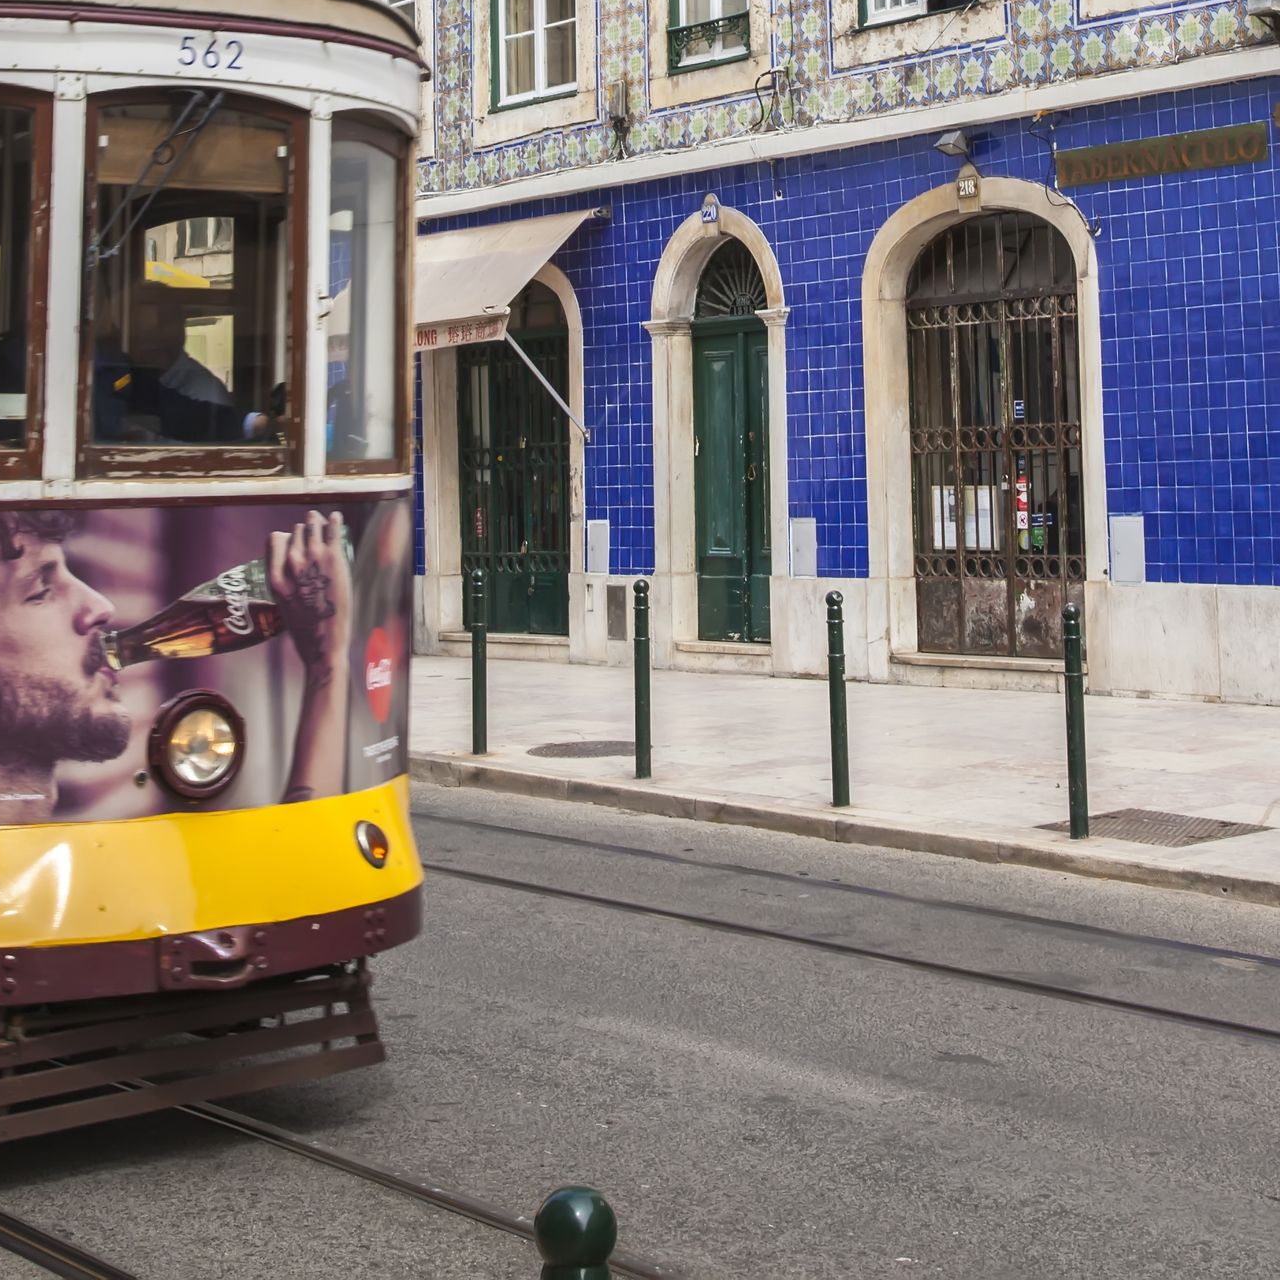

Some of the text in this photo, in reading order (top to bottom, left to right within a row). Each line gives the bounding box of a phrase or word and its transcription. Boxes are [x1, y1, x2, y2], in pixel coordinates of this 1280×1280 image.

[178, 36, 244, 70] 562
[958, 179, 976, 196] 218
[701, 202, 718, 221] 220
[414, 328, 437, 347] ONG
